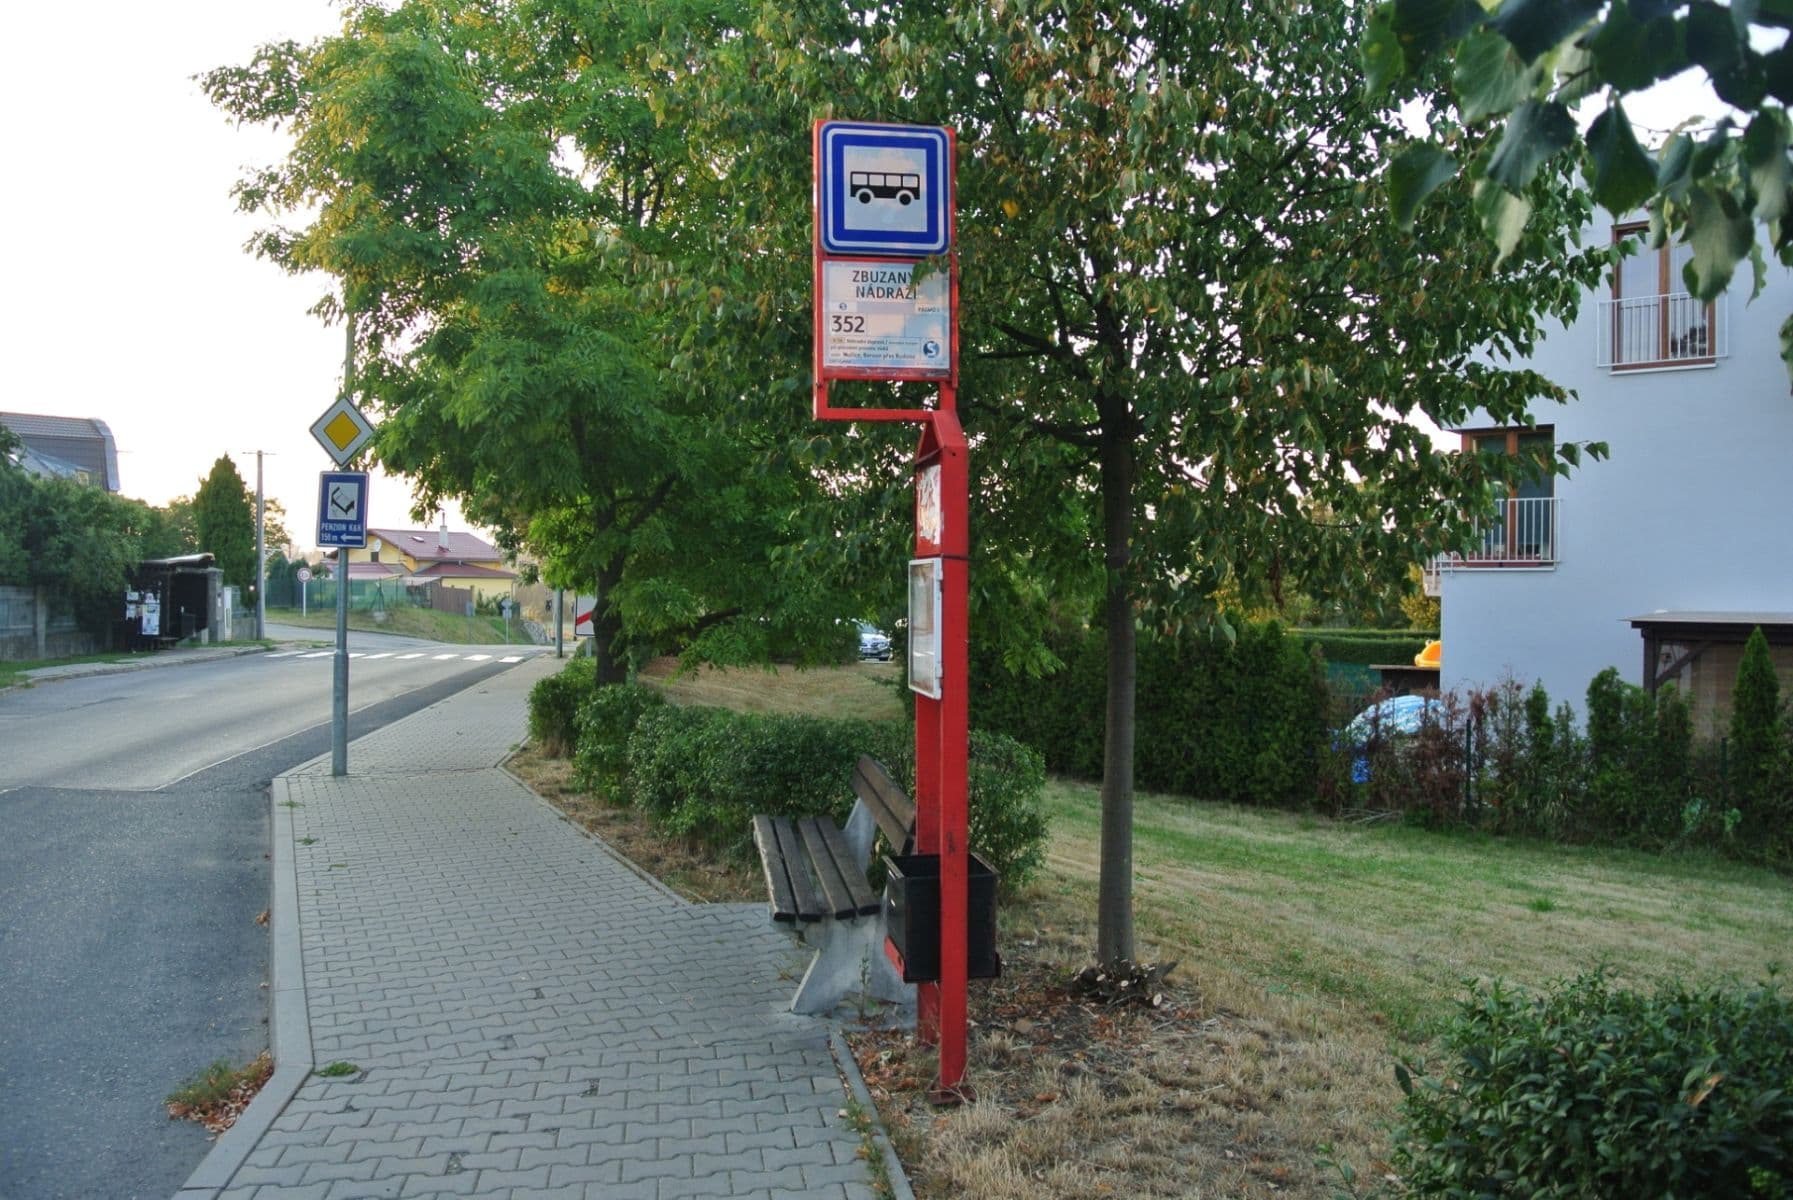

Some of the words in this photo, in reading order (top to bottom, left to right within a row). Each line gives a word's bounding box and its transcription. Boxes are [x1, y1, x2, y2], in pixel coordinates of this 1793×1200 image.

[831, 315, 865, 333] 352
[321, 523, 347, 532] PENZION
[321, 533, 331, 542] 150
